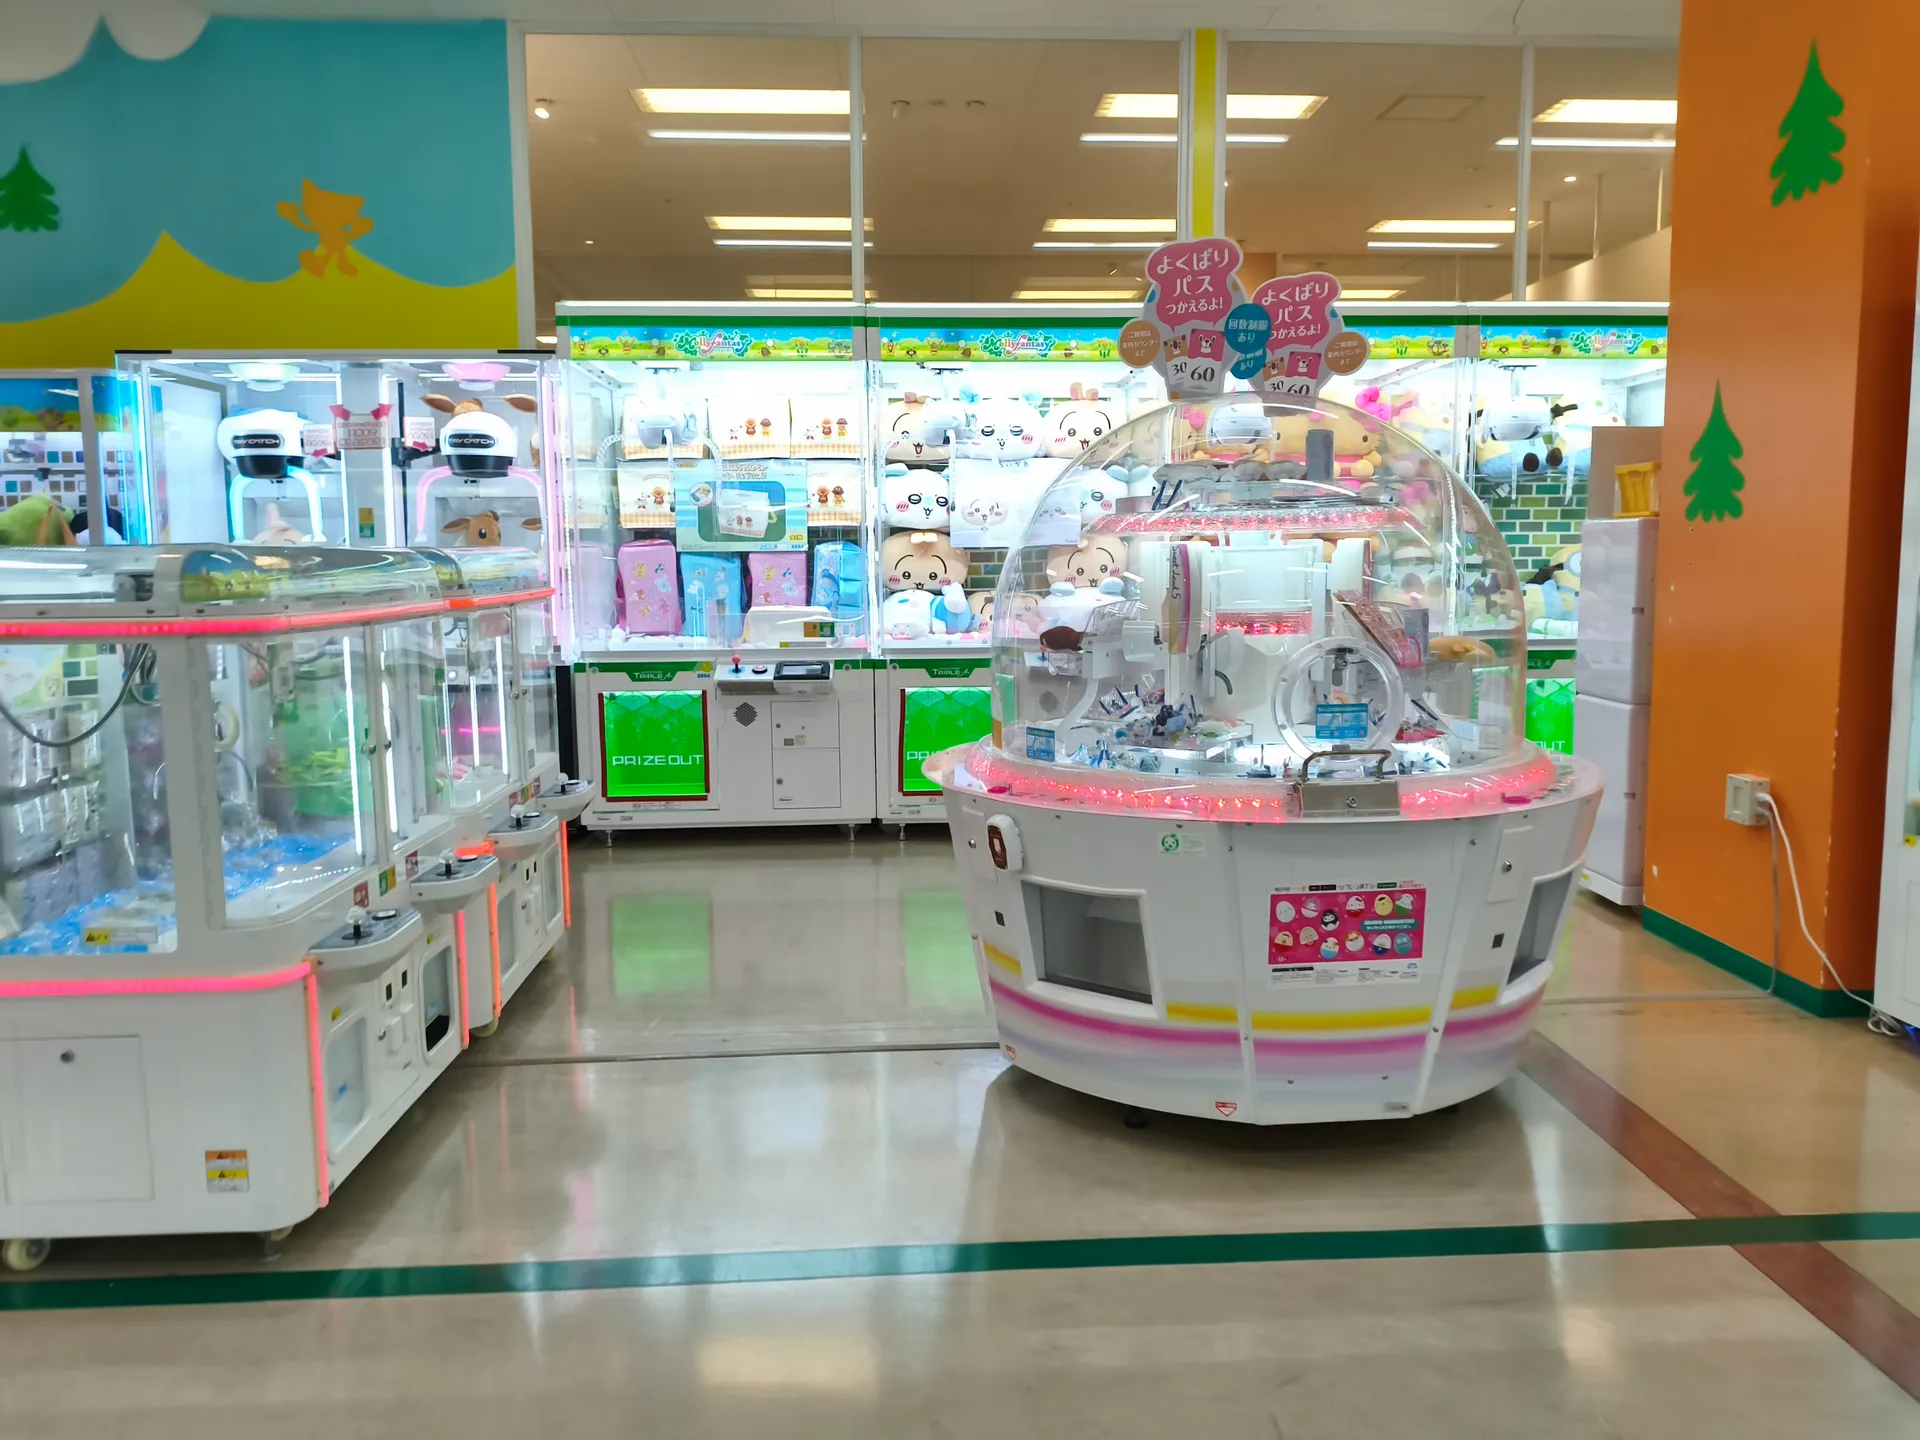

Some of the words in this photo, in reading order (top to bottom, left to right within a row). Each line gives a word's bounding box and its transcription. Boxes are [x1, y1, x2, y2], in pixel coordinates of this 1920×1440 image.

[1157, 248, 1229, 275] よくばり
[1173, 275, 1214, 297] パス
[1261, 281, 1329, 306] よくばり
[1166, 297, 1223, 315] つかえるよ!
[1274, 305, 1313, 324] パス
[1228, 318, 1269, 331] 回数制限
[1237, 332, 1256, 343] あり
[1172, 362, 1188, 377] 30
[1190, 365, 1215, 383] 60
[1239, 360, 1255, 371] あり
[1269, 380, 1285, 392] 30
[1171, 545, 1182, 569] Sweet
